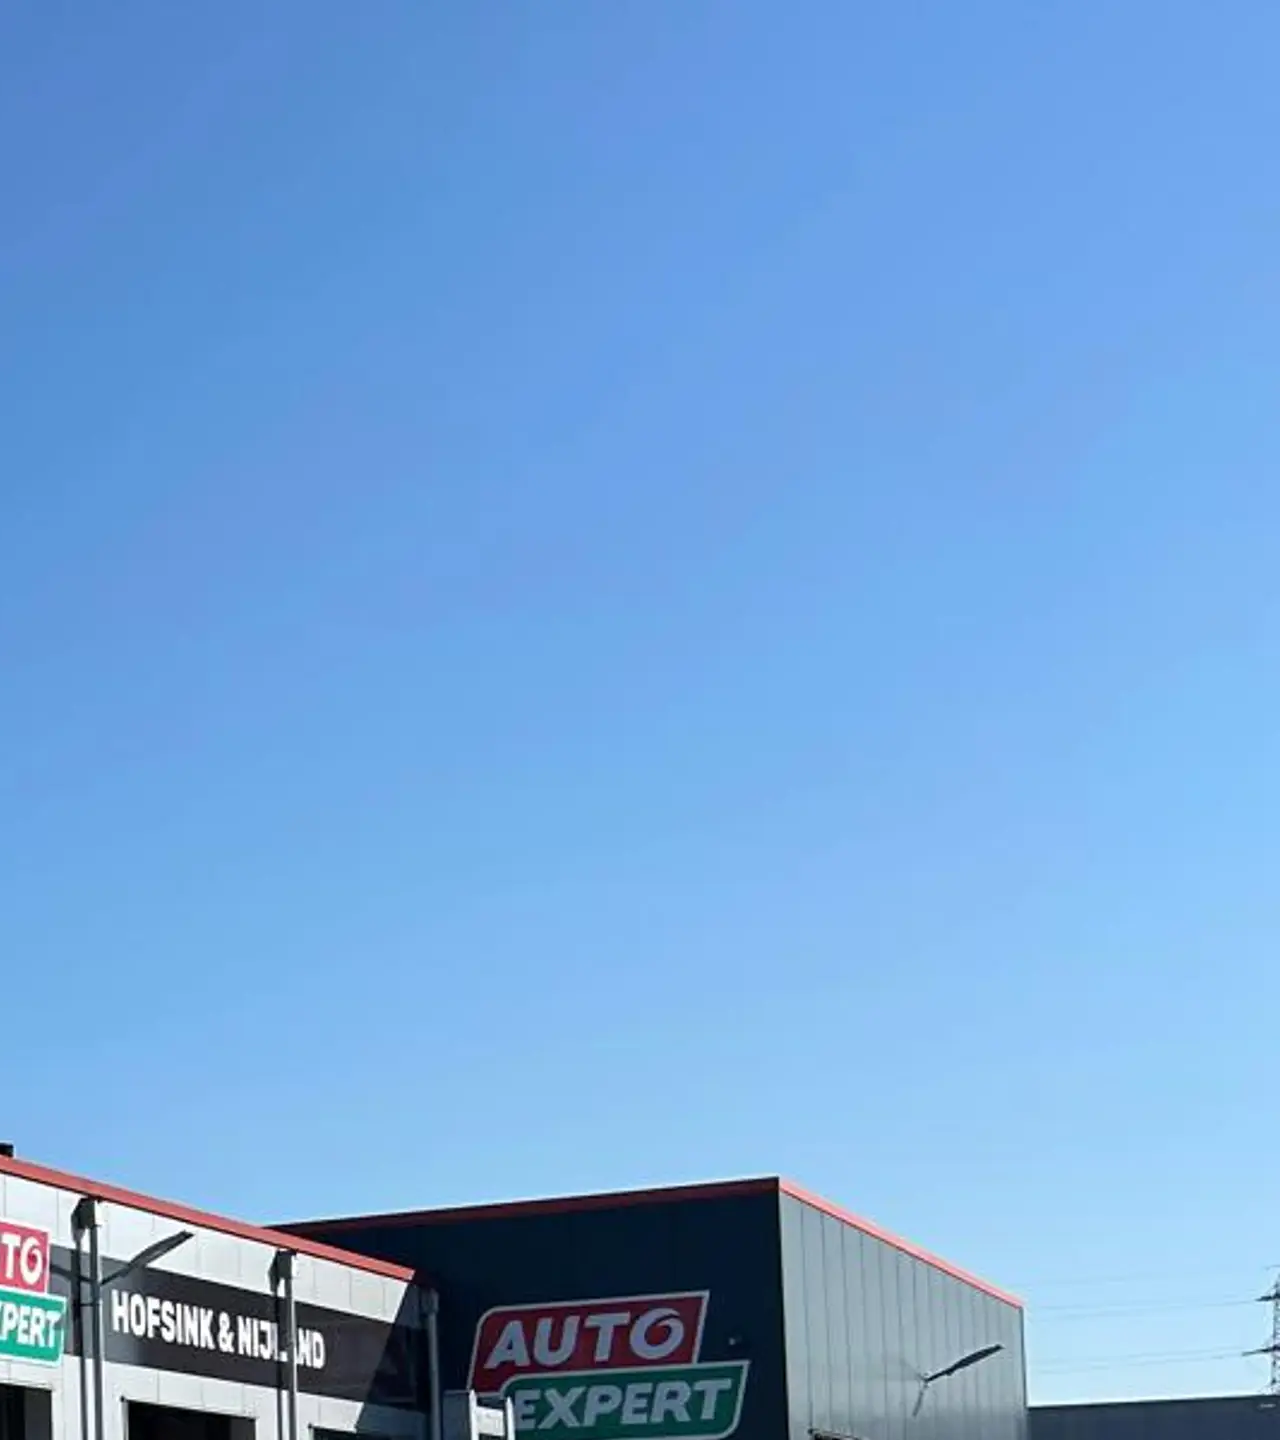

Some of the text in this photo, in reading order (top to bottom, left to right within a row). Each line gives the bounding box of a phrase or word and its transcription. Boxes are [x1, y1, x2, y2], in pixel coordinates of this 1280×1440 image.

[111, 1289, 326, 1369] HOFSINK & NIJLND
[483, 1308, 685, 1369] AUTO
[513, 1378, 733, 1430] EXPERT
